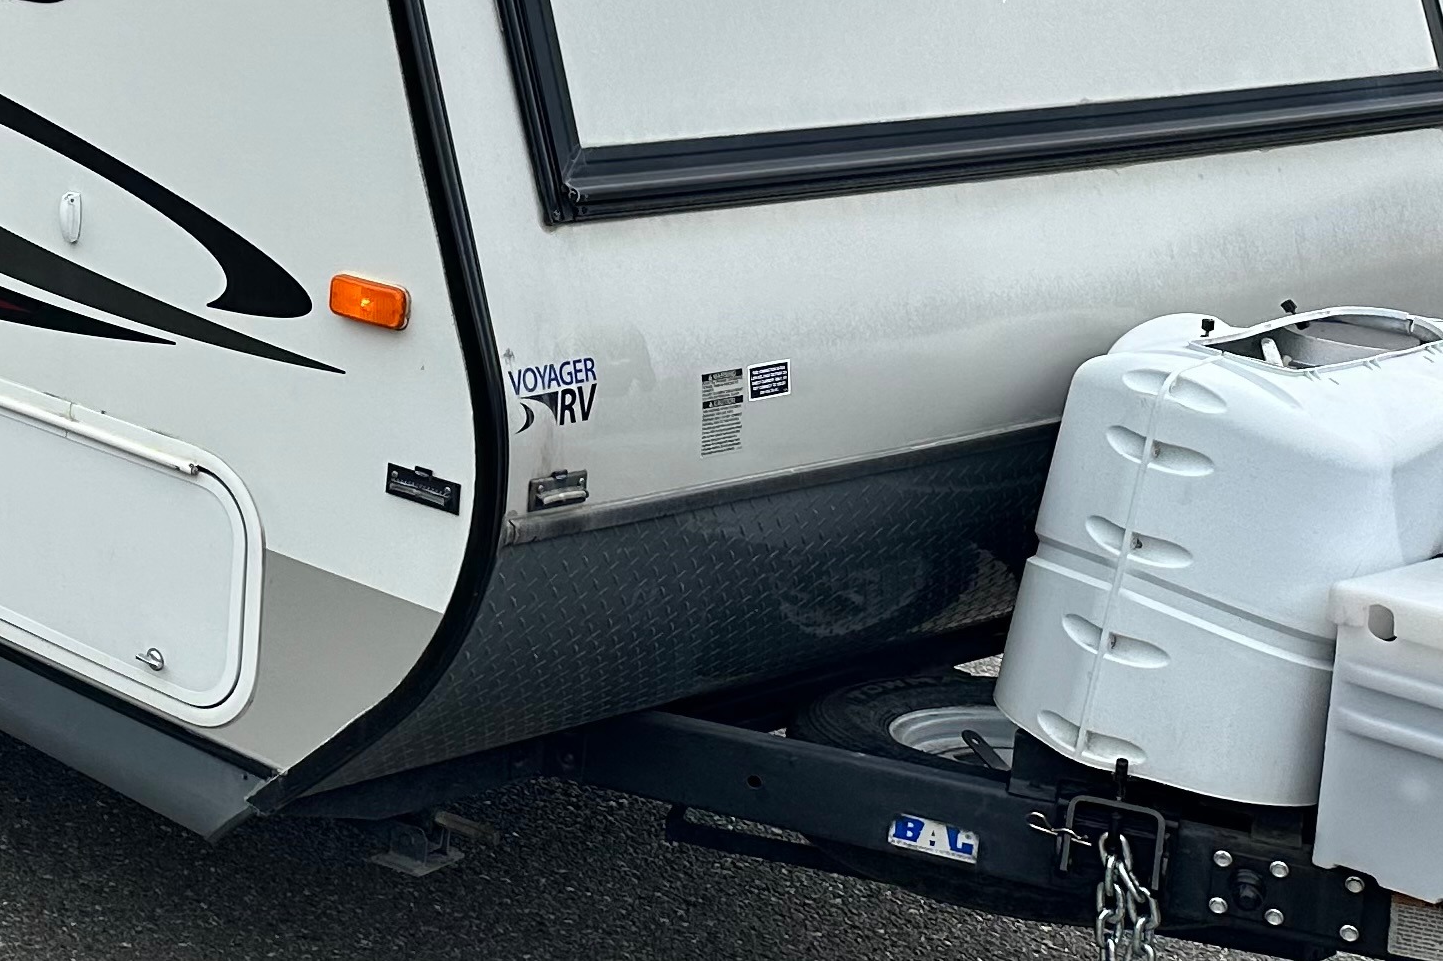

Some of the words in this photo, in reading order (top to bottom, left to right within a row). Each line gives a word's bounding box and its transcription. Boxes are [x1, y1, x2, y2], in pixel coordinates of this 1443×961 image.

[508, 357, 598, 395] VOYAGER
[559, 383, 598, 426] RV
[893, 816, 974, 856] BAL
